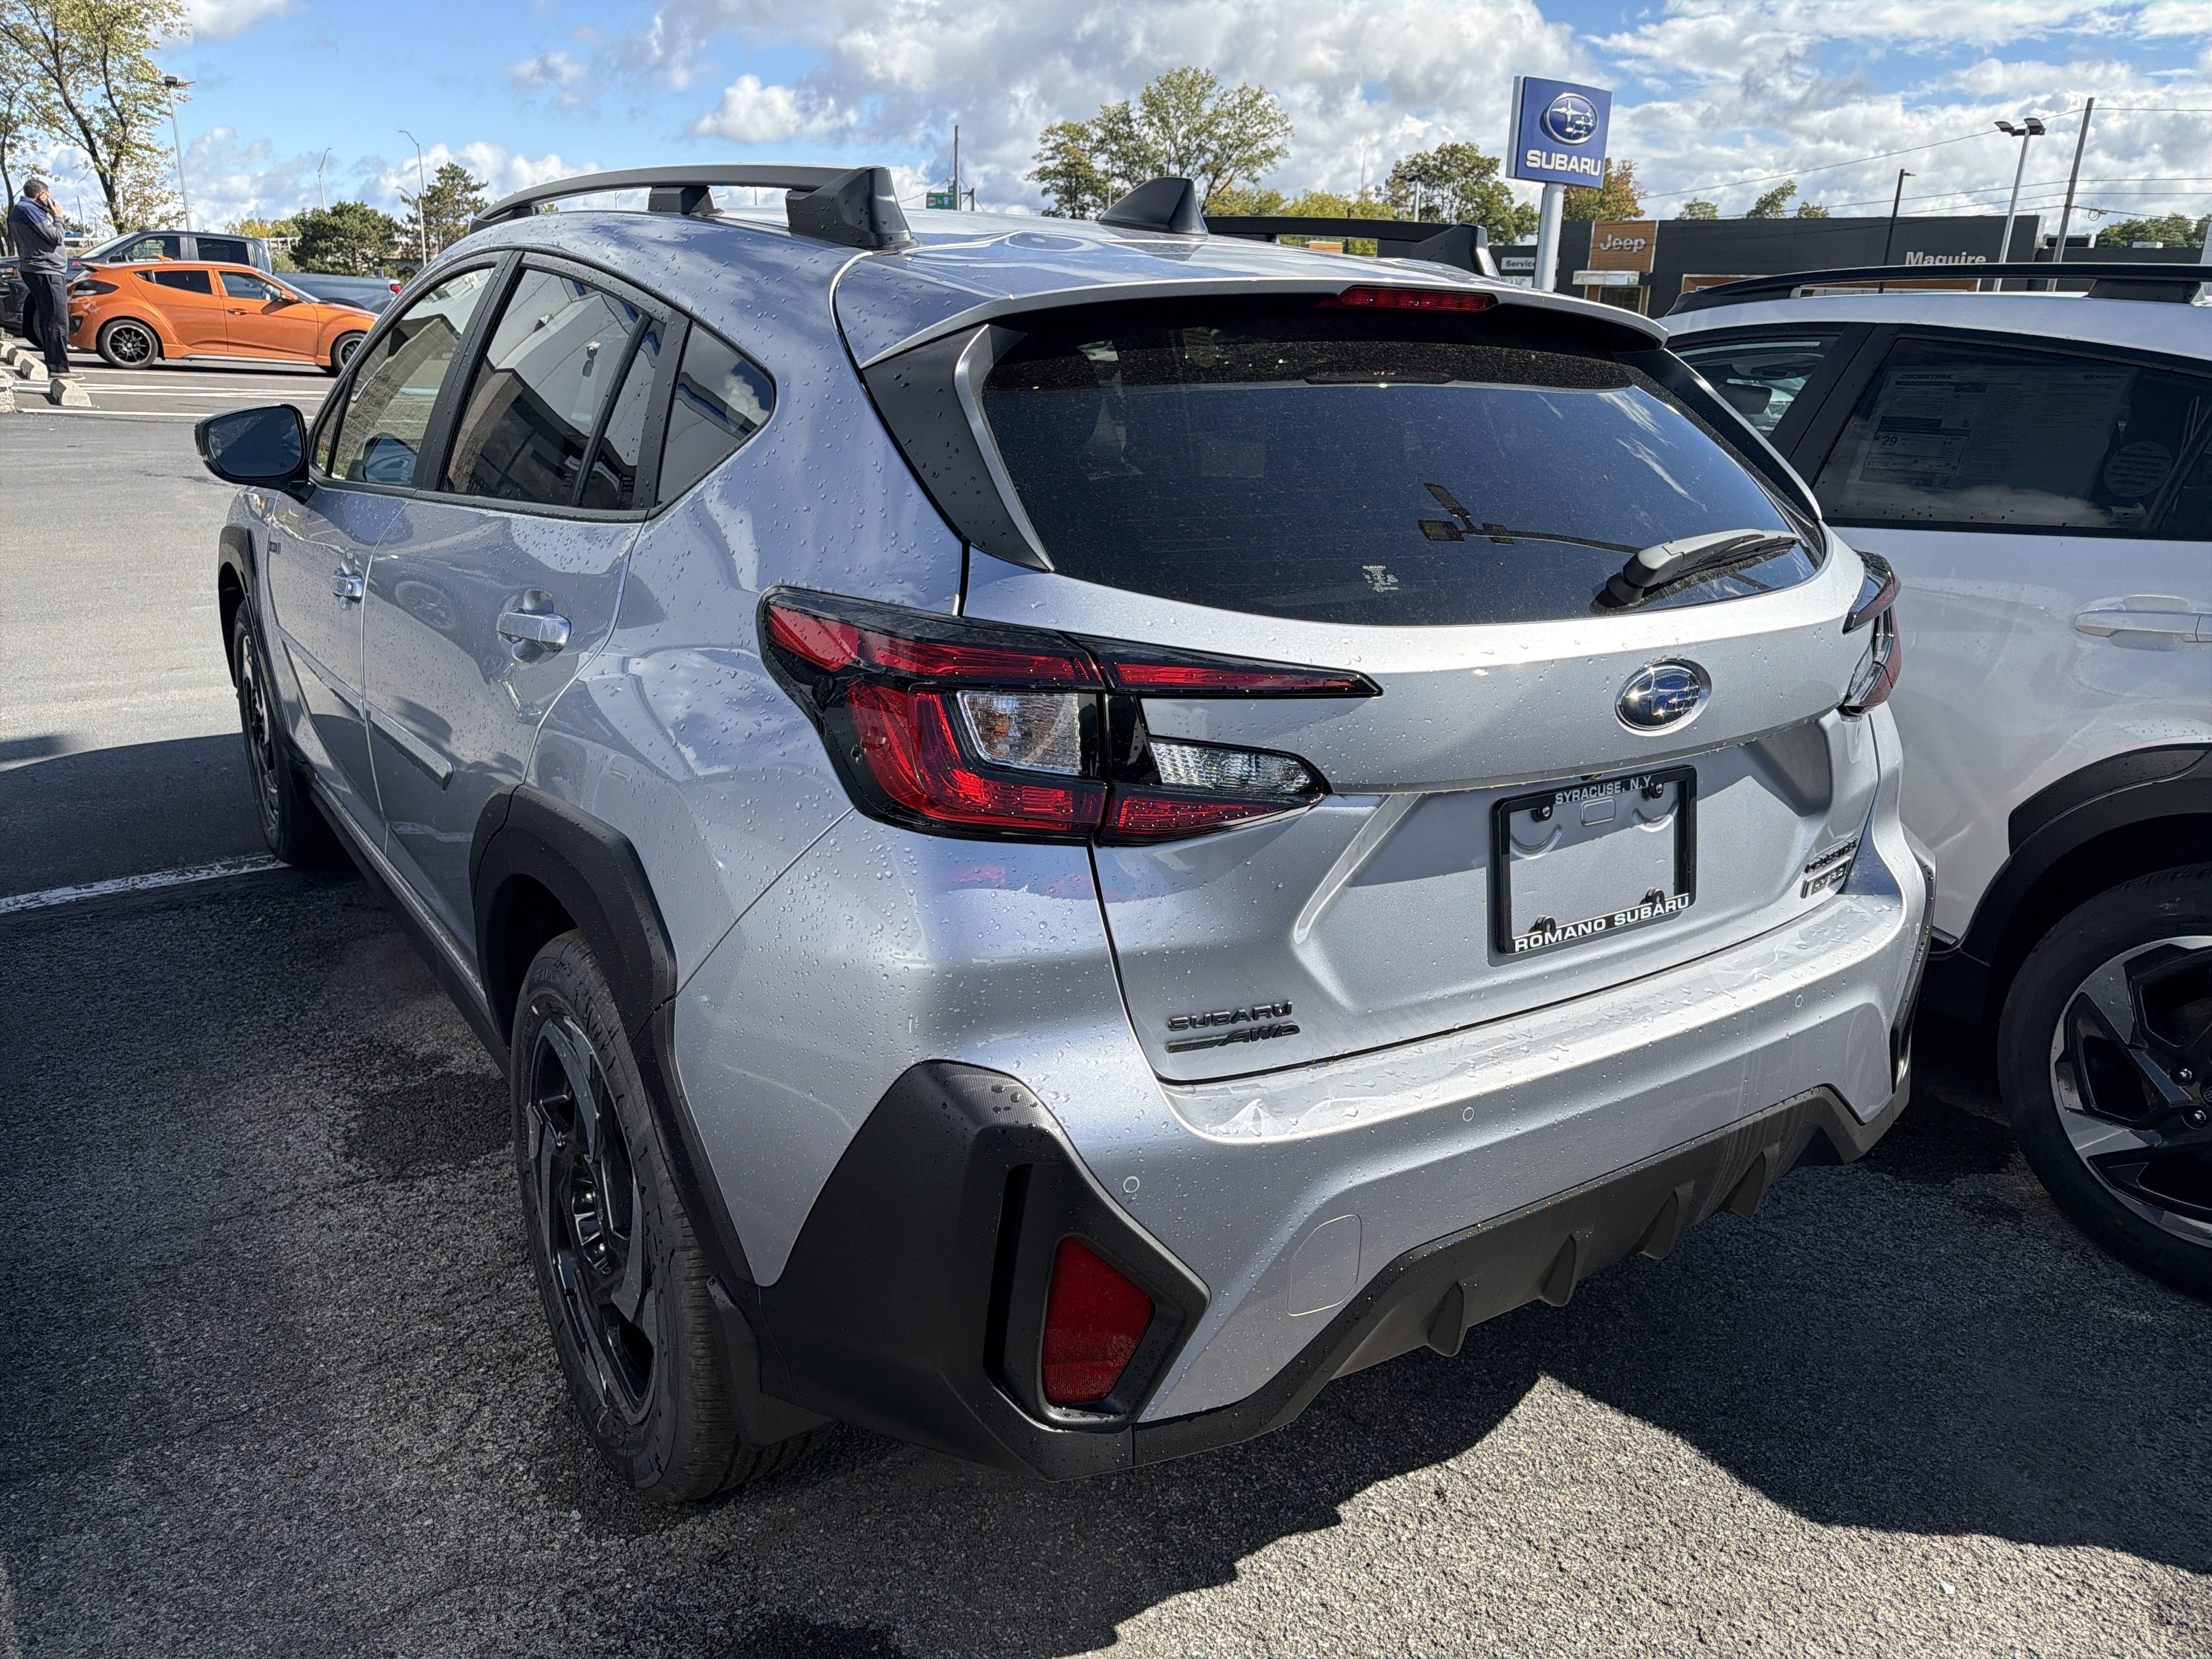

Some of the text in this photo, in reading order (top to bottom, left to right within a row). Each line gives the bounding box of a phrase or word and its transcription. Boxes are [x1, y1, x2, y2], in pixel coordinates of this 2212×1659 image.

[1526, 149, 1601, 176] SUBARU
[1599, 234, 1646, 253] Jeep
[1881, 436, 1897, 446] 29
[1629, 776, 1654, 791] N.Y.
[1514, 895, 1690, 952] ROMANO SUBARU
[1167, 1000, 1293, 1032] SUBARU
[1217, 1022, 1300, 1047] AWD
